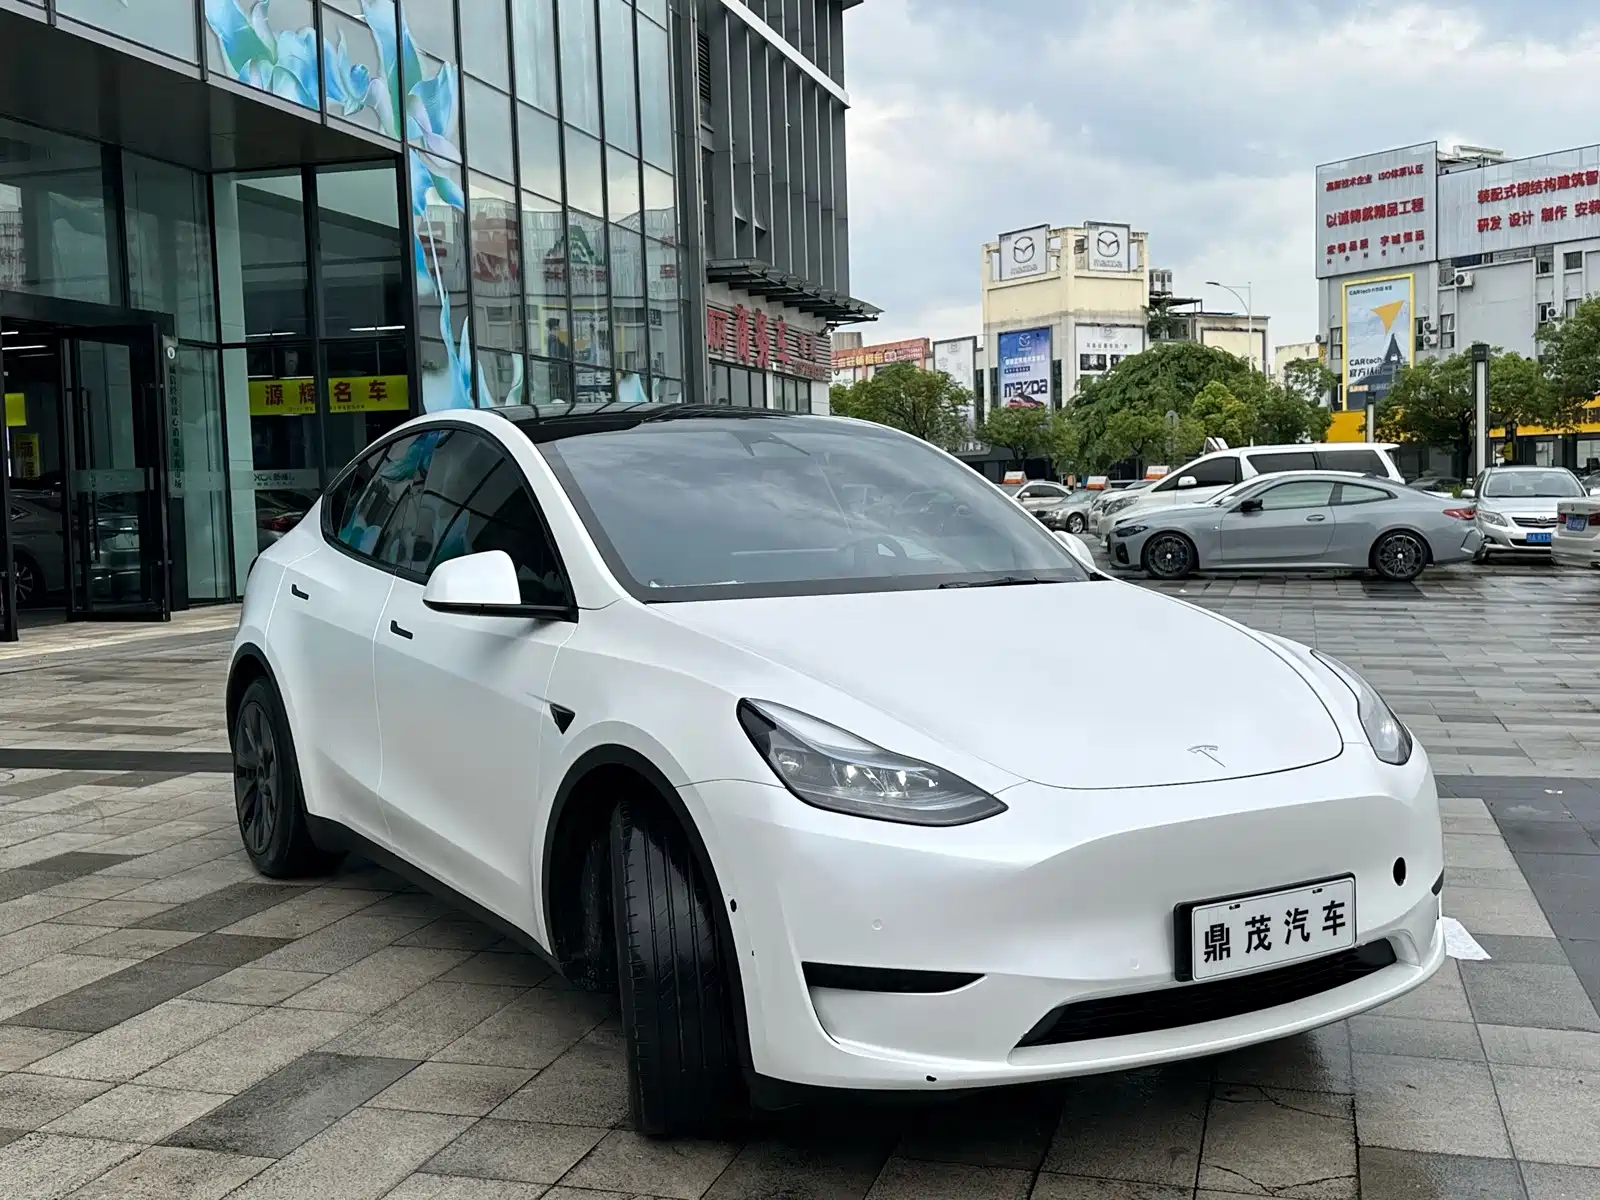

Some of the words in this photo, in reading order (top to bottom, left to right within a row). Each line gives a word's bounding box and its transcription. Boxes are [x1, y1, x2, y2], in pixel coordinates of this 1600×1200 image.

[1477, 215, 1502, 233] 研发
[1508, 210, 1534, 228] 设计
[1541, 205, 1567, 222] 制作
[1203, 900, 1346, 963] 鼎茂汽车
